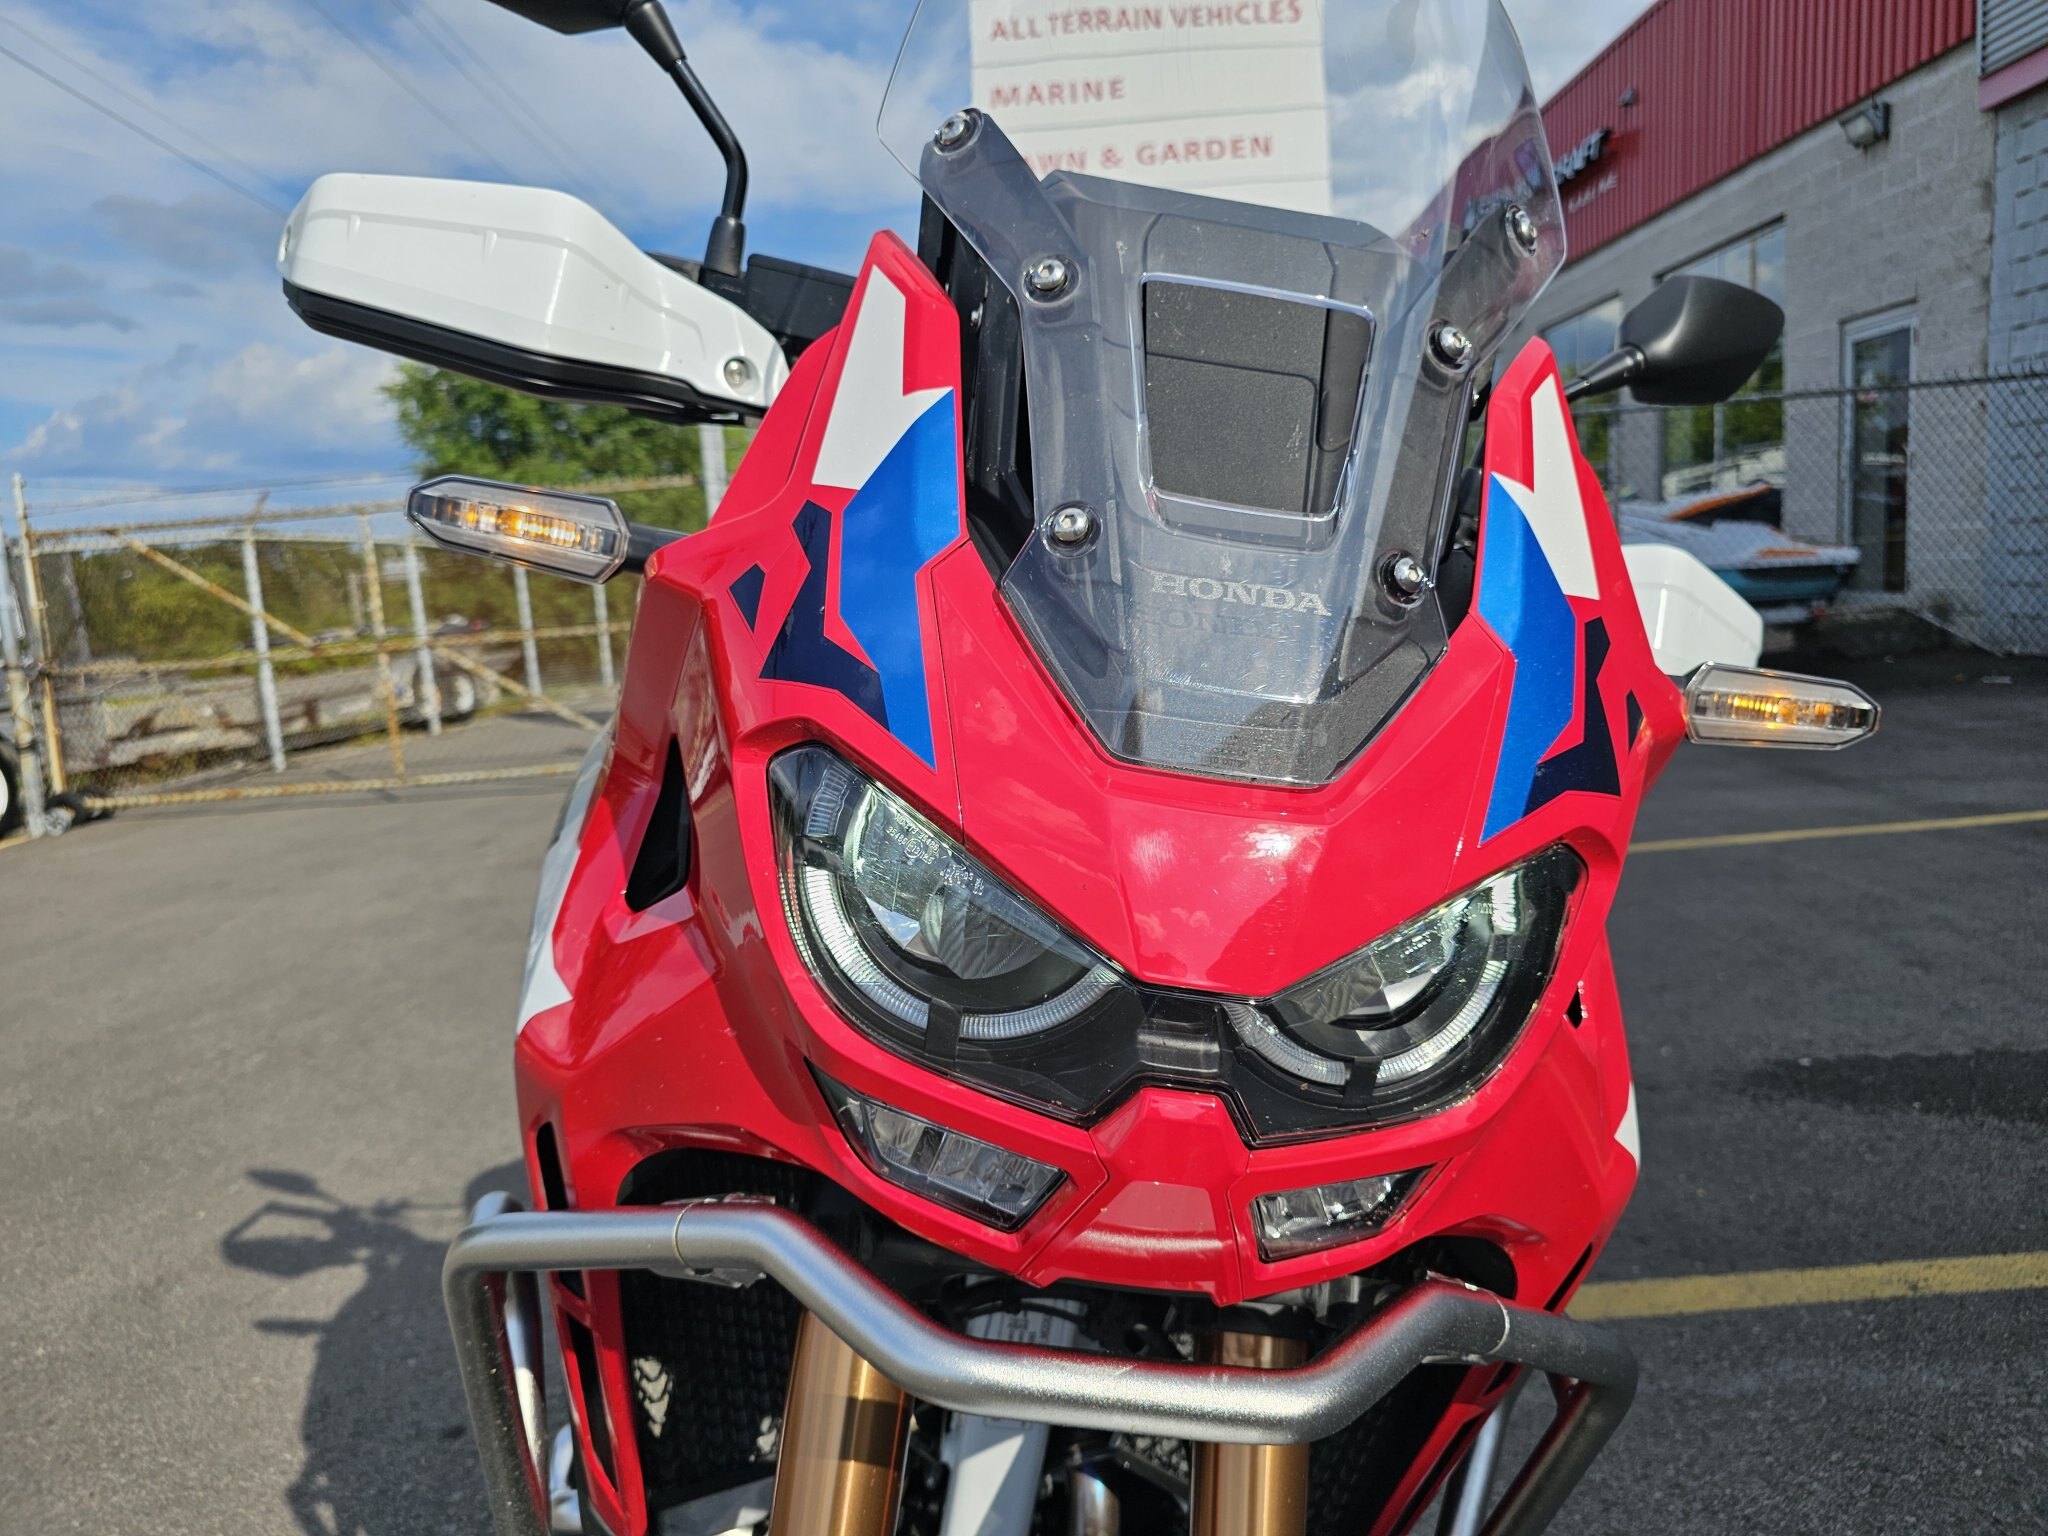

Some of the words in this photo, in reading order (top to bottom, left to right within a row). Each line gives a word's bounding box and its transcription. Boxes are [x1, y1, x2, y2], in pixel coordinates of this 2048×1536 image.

[991, 16, 1041, 41] ALL
[1050, 8, 1163, 35] TERRAIN
[1169, 0, 1303, 29] VEHICLES
[991, 77, 1125, 109] MARINE
[1101, 145, 1124, 169] &
[1136, 134, 1273, 166] GARDEN
[1151, 572, 1332, 617] HONDA
